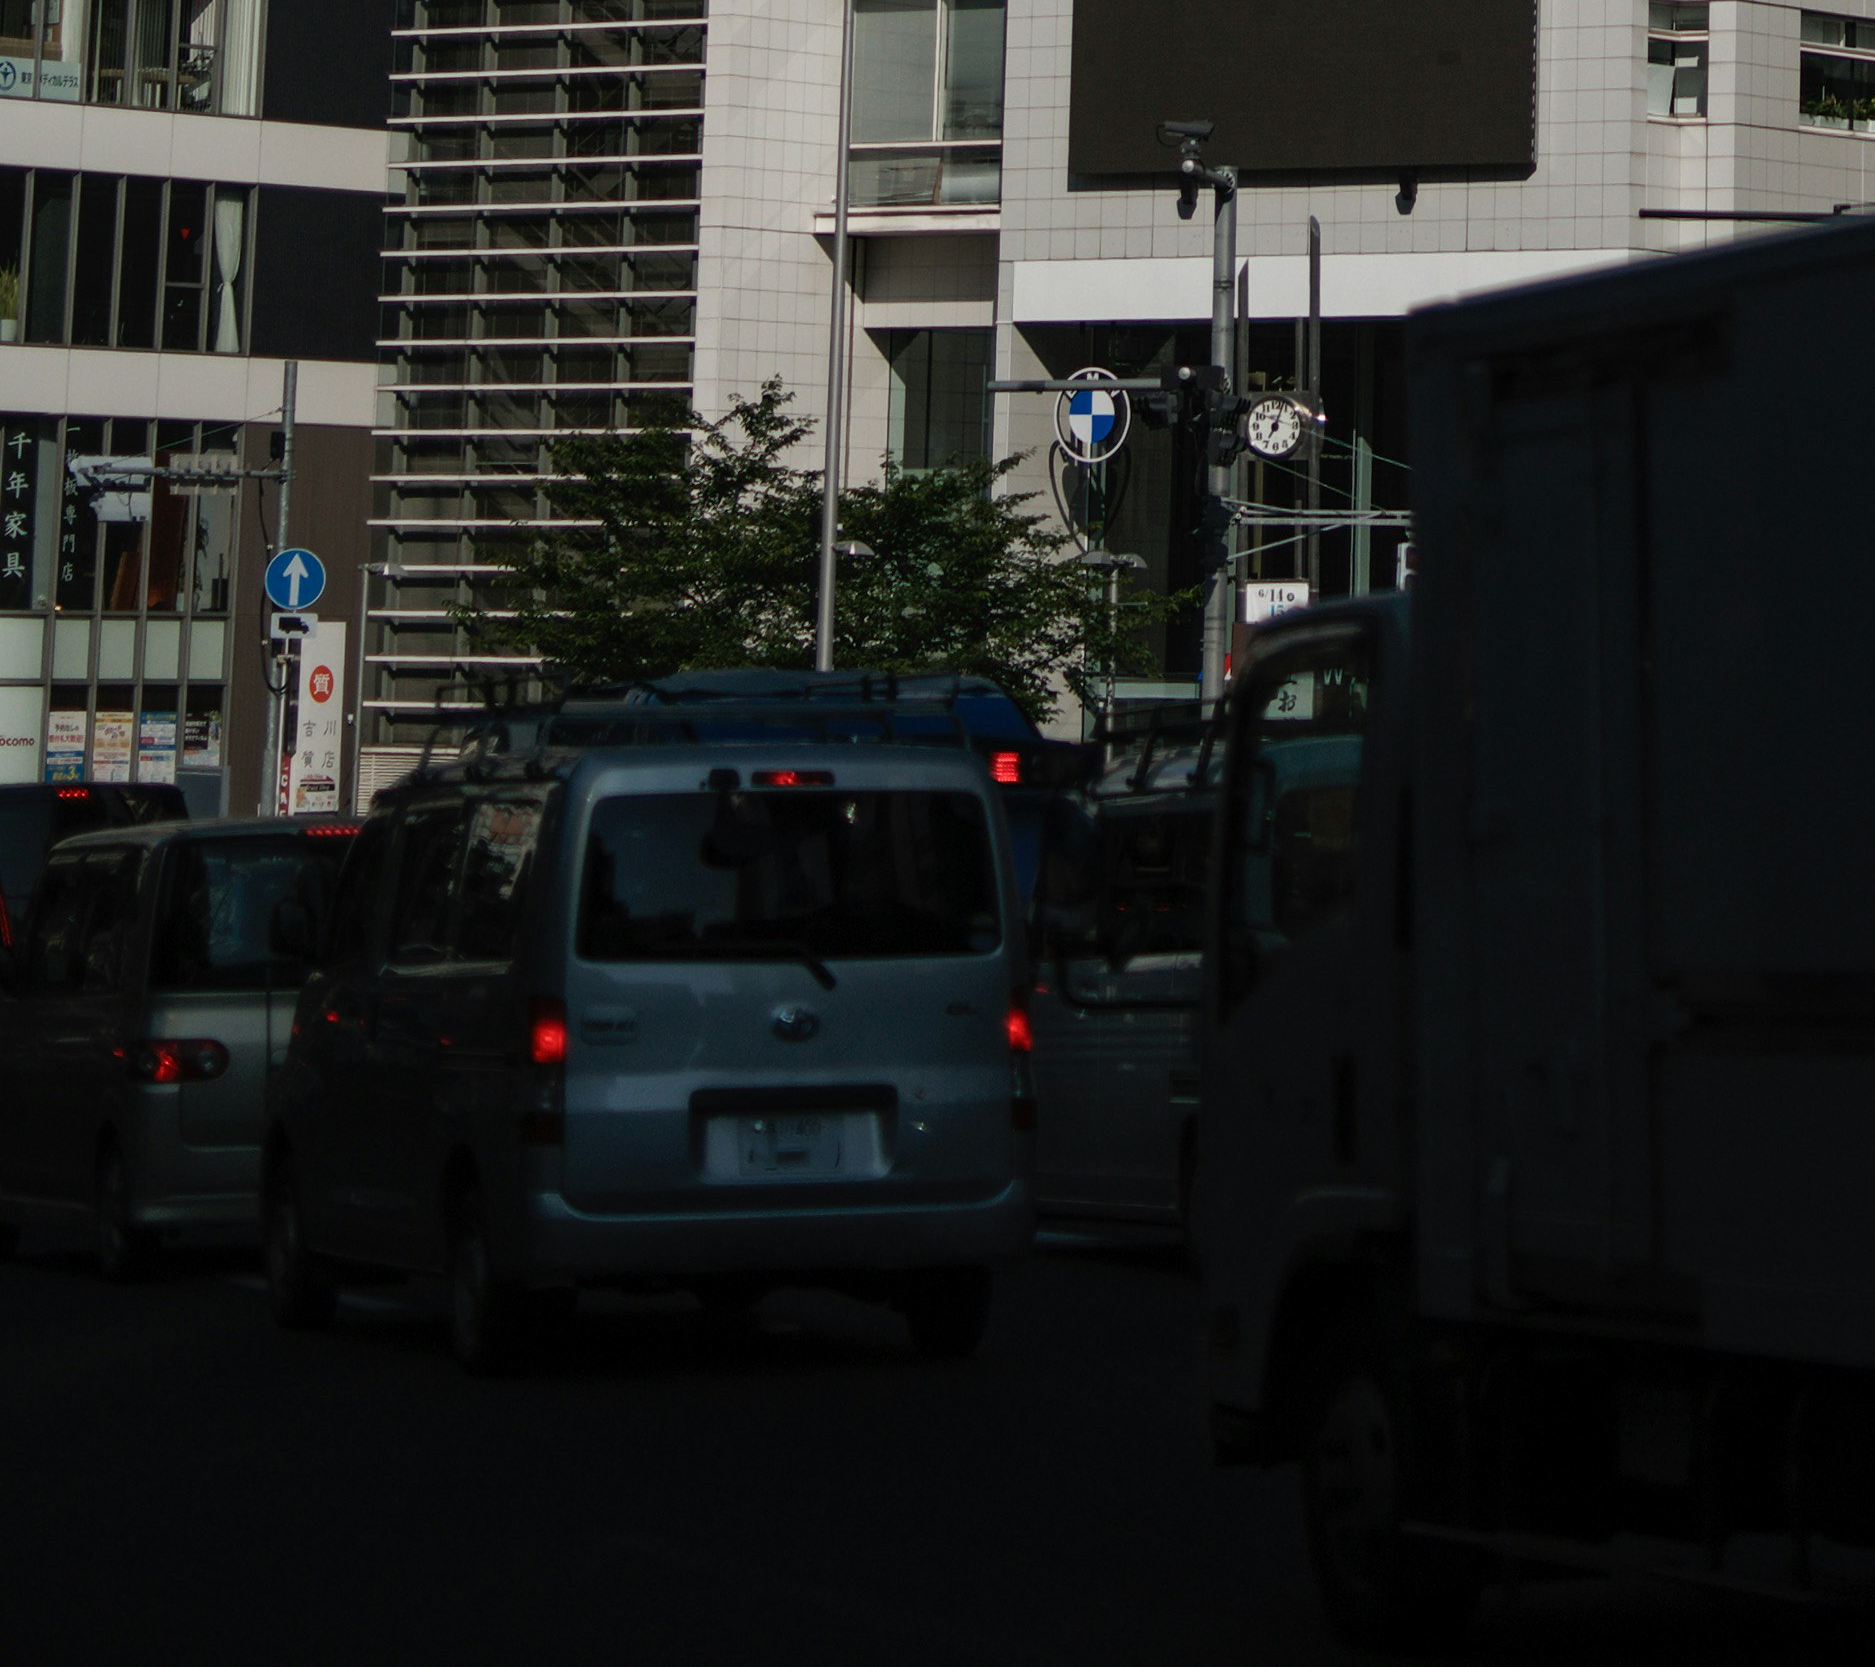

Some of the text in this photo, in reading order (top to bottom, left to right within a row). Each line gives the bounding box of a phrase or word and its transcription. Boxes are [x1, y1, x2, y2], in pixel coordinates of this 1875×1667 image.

[2, 432, 32, 578] 千年家具
[313, 673, 330, 695] 質
[303, 720, 337, 737] 吉川
[302, 750, 335, 768] 質店
